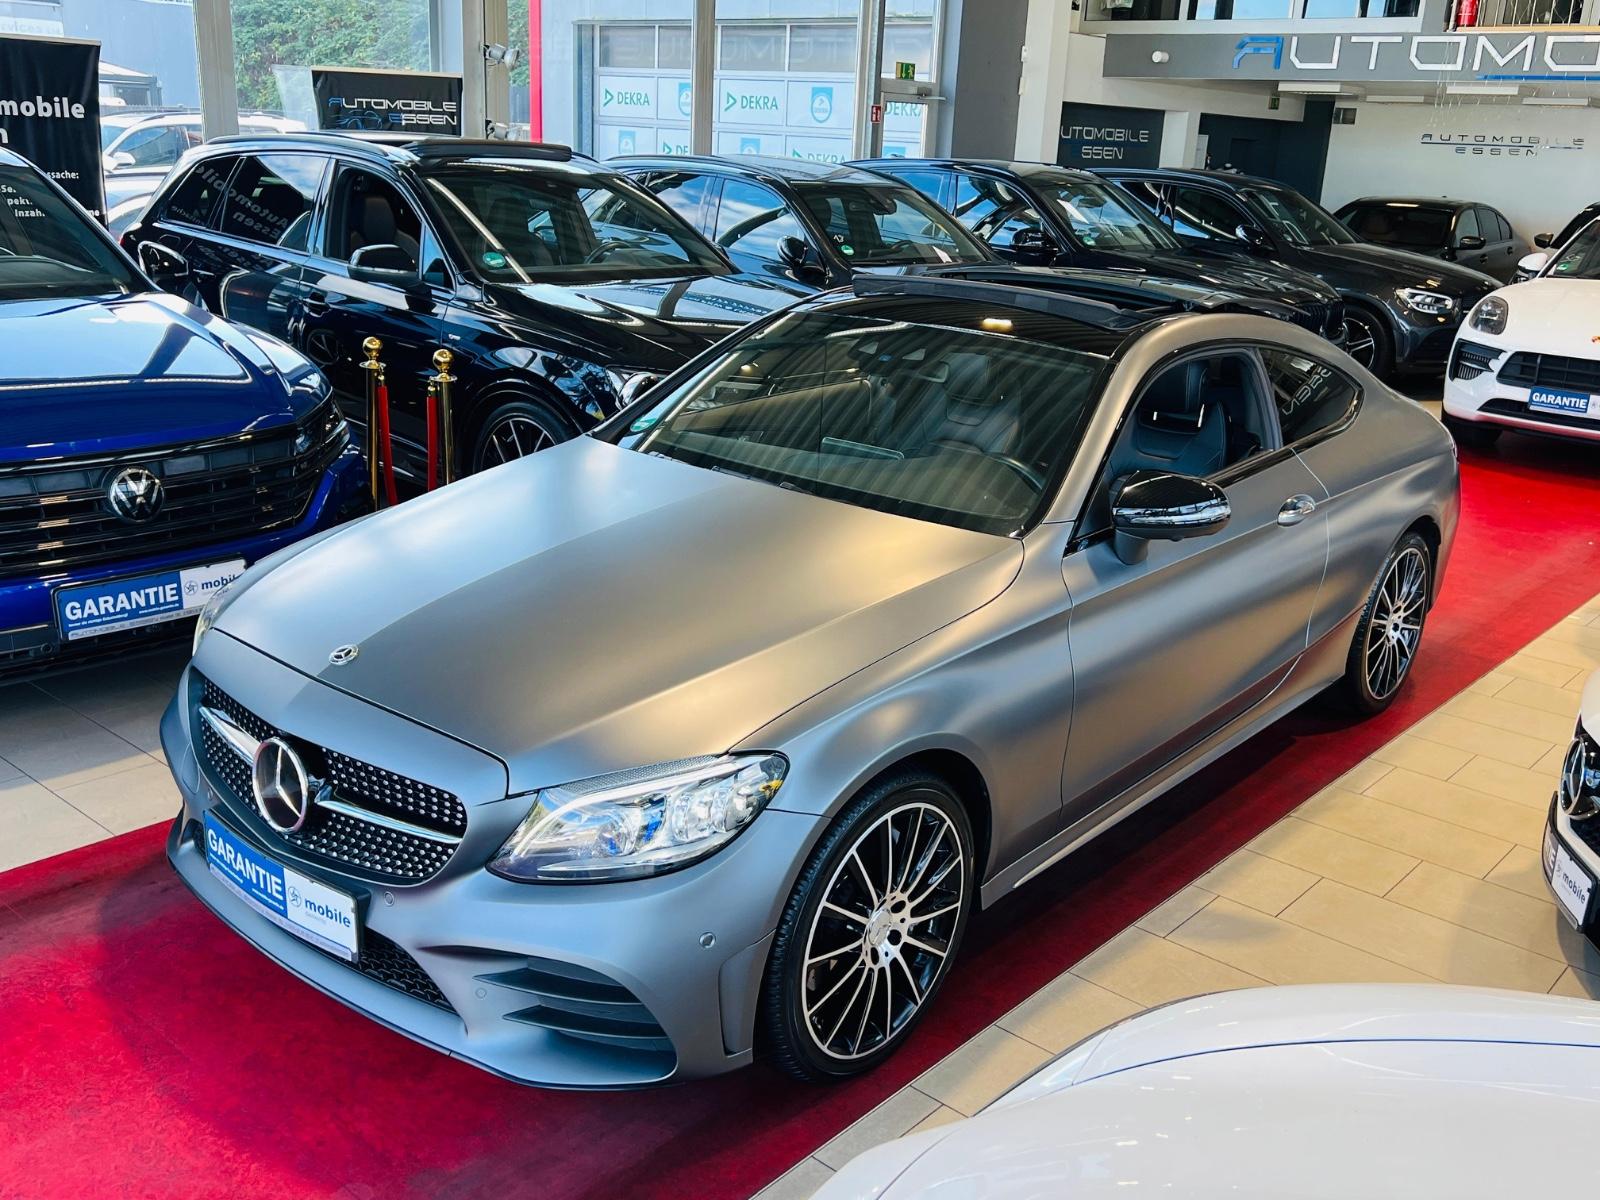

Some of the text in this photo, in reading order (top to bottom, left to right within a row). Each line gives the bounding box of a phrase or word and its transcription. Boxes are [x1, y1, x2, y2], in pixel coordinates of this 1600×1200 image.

[328, 97, 457, 112] AUTOMOBILE
[617, 91, 650, 106] DEKRA
[740, 95, 779, 111] DEKRA
[388, 113, 457, 126] ESSEN
[1060, 125, 1150, 143] UTOMOBILE
[1421, 133, 1585, 146] AUTOMOBILE
[1081, 146, 1124, 159] SSEN
[1455, 146, 1538, 157] ESSEN
[1532, 392, 1588, 409] GARANTIE
[65, 583, 179, 621] GARANTIE
[207, 828, 285, 901] GARANTIE
[304, 897, 351, 928] mobile
[1563, 873, 1586, 904] mobile
